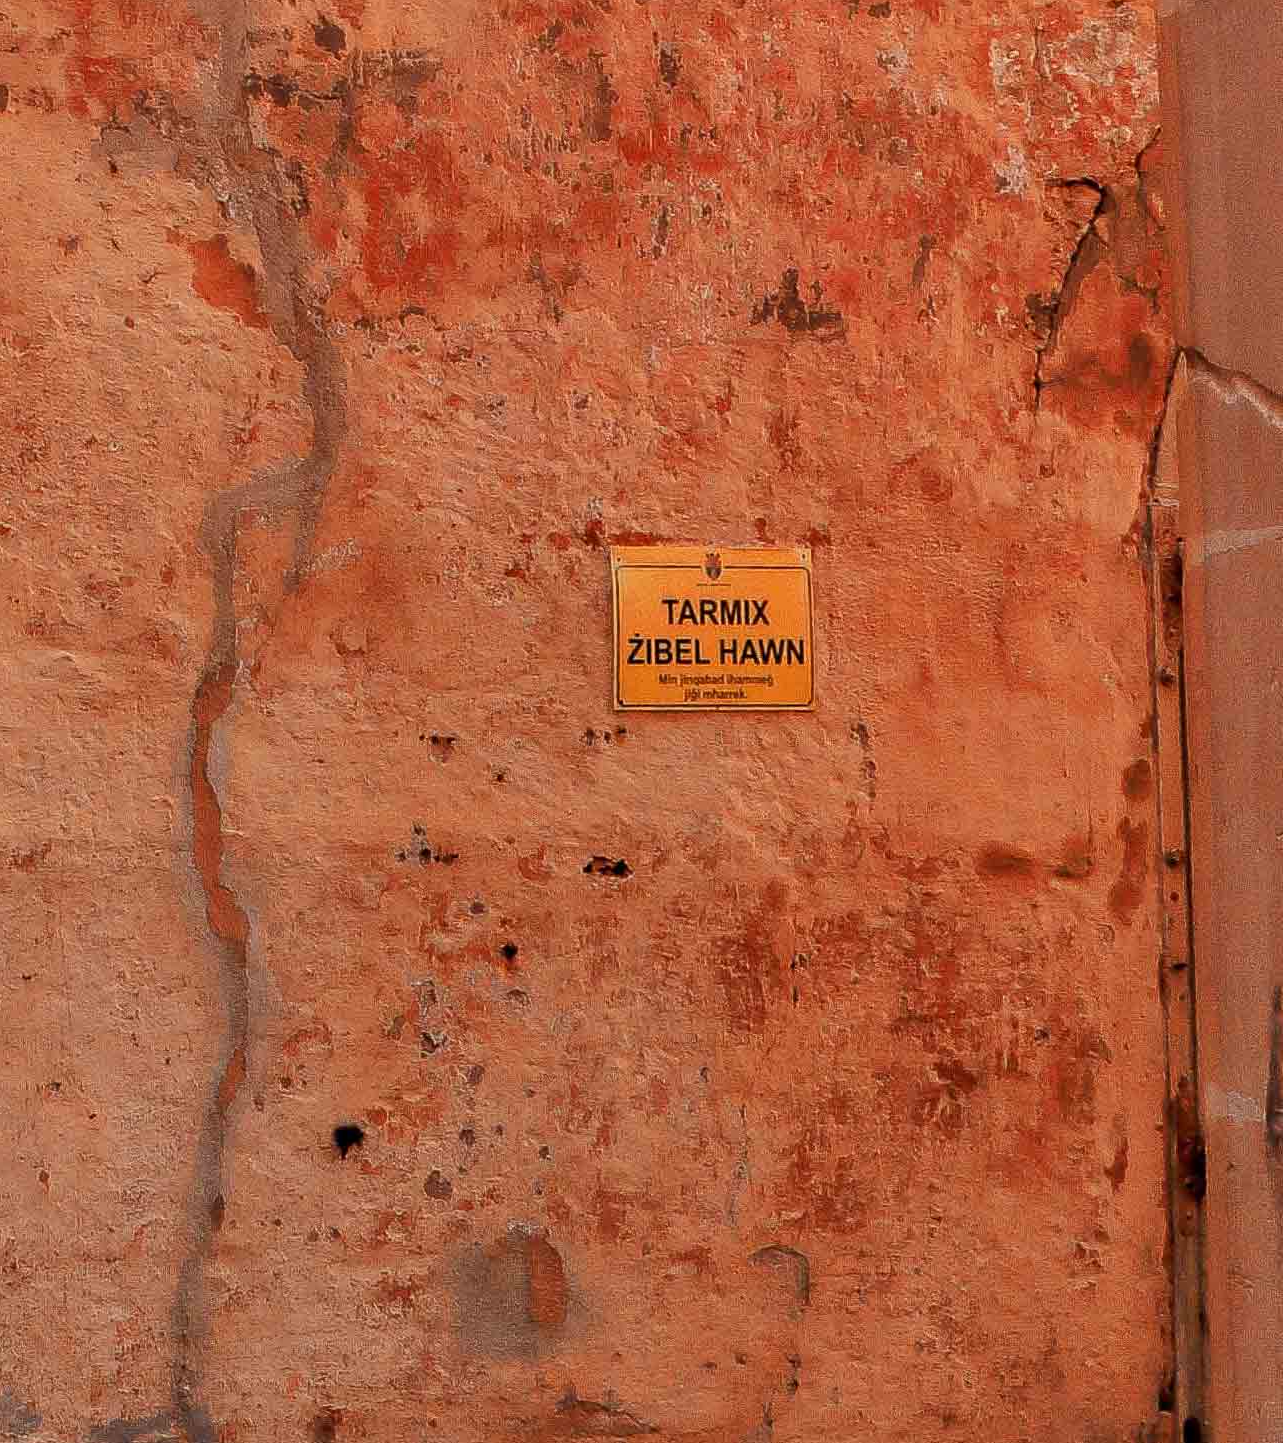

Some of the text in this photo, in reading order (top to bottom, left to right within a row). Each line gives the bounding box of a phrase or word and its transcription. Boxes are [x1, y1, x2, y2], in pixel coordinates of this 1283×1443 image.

[662, 599, 770, 625] TARMIX
[627, 633, 805, 665] ŻIBEL HAWN
